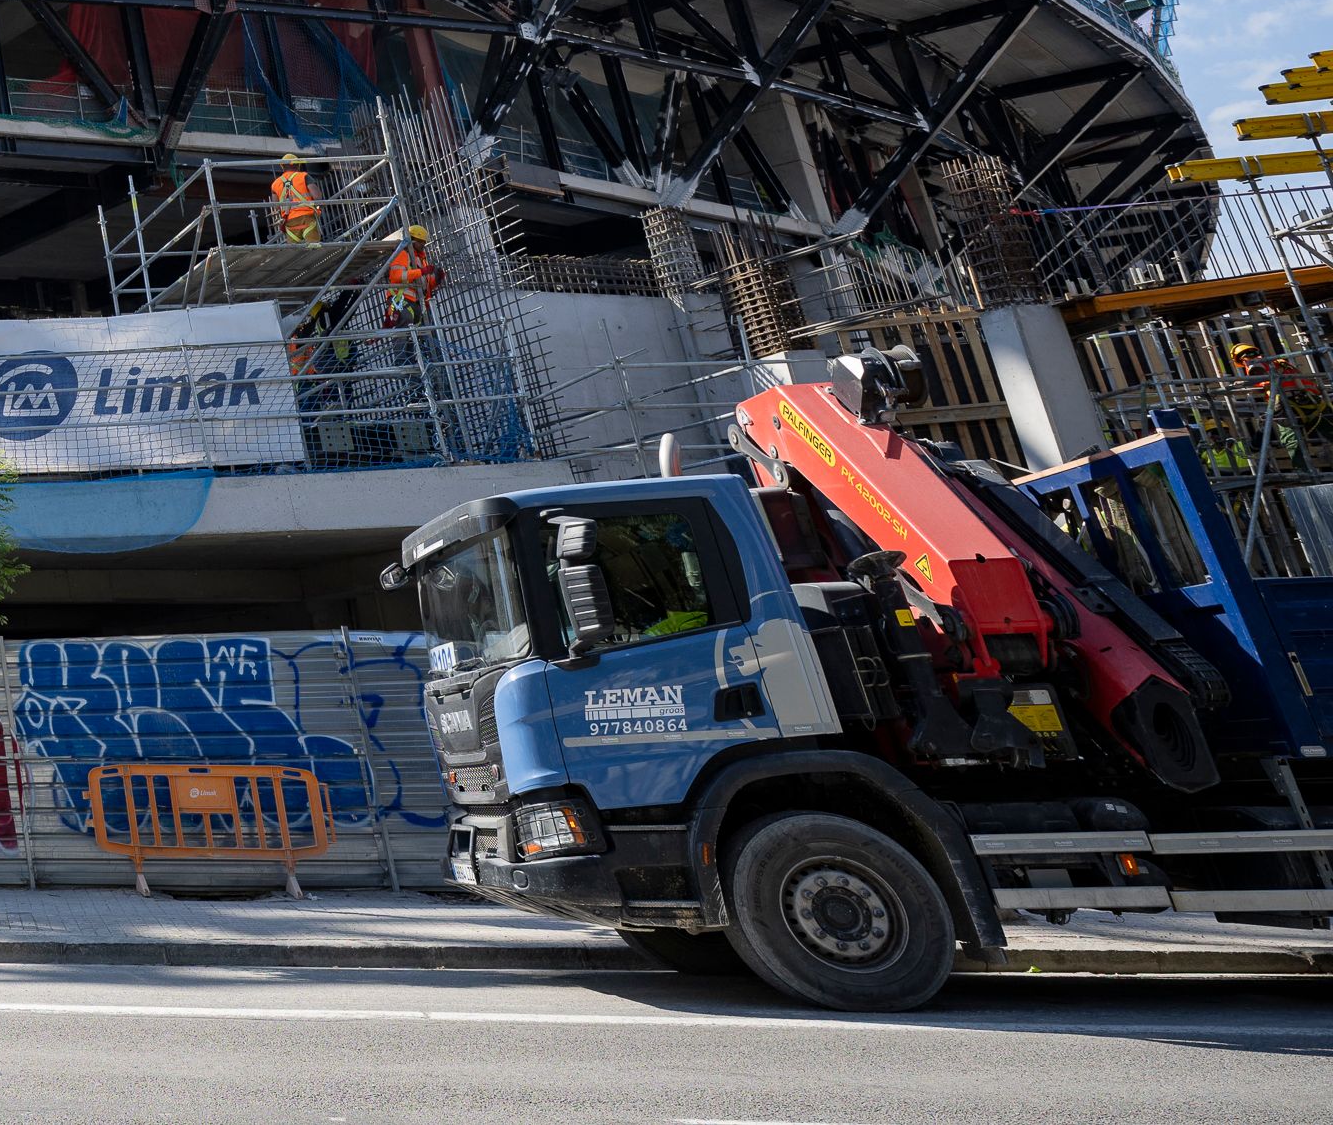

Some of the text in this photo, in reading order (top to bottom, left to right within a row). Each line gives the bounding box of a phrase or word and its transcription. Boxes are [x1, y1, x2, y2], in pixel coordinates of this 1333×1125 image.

[94, 358, 265, 415] Limak
[782, 404, 833, 463] PALFINGER
[840, 466, 855, 486] PK
[584, 684, 684, 709] LEMAN
[439, 709, 474, 735] SCANIA
[589, 718, 688, 736] 977840864
